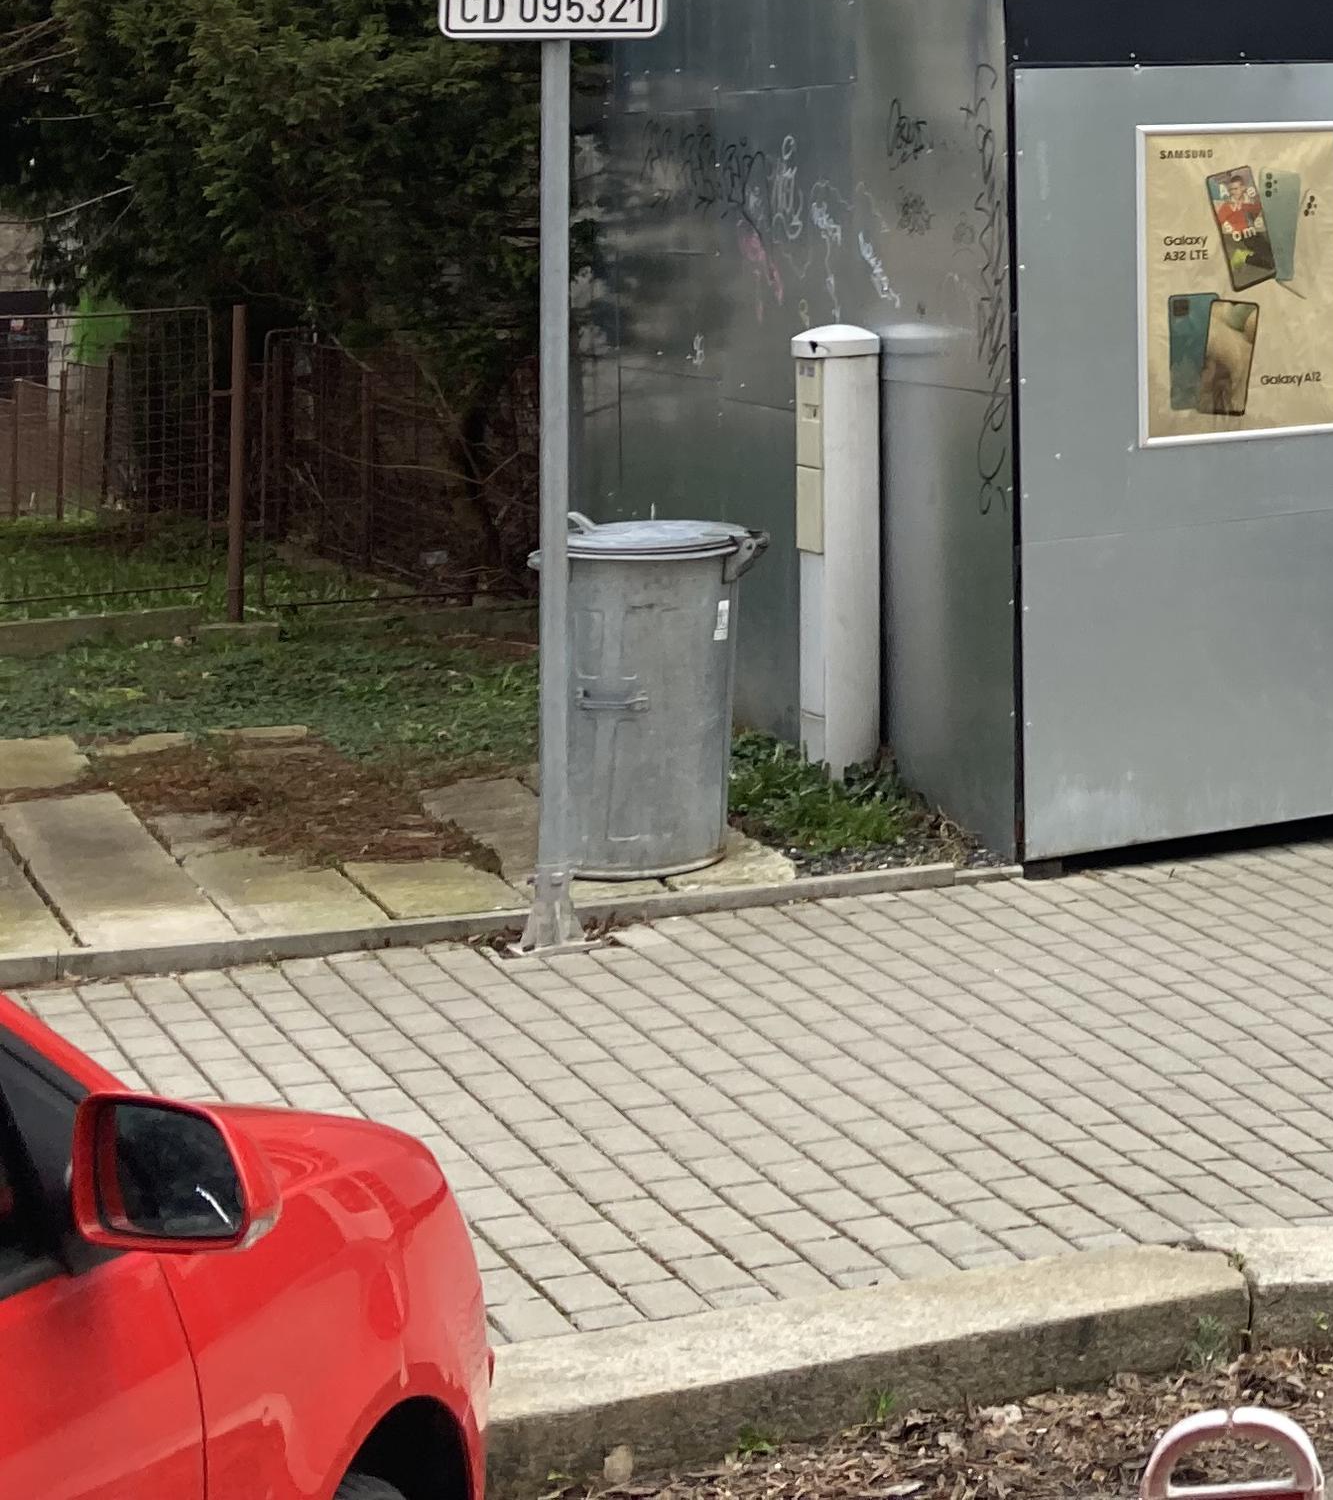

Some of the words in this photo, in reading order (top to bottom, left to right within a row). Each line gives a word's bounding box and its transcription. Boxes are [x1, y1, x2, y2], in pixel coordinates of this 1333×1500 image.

[1159, 149, 1214, 160] SAMSUNG
[1163, 235, 1209, 248] Galaxy
[1163, 250, 1187, 262] A32
[1189, 249, 1209, 261] LTE
[1260, 373, 1303, 387] Galaxy
